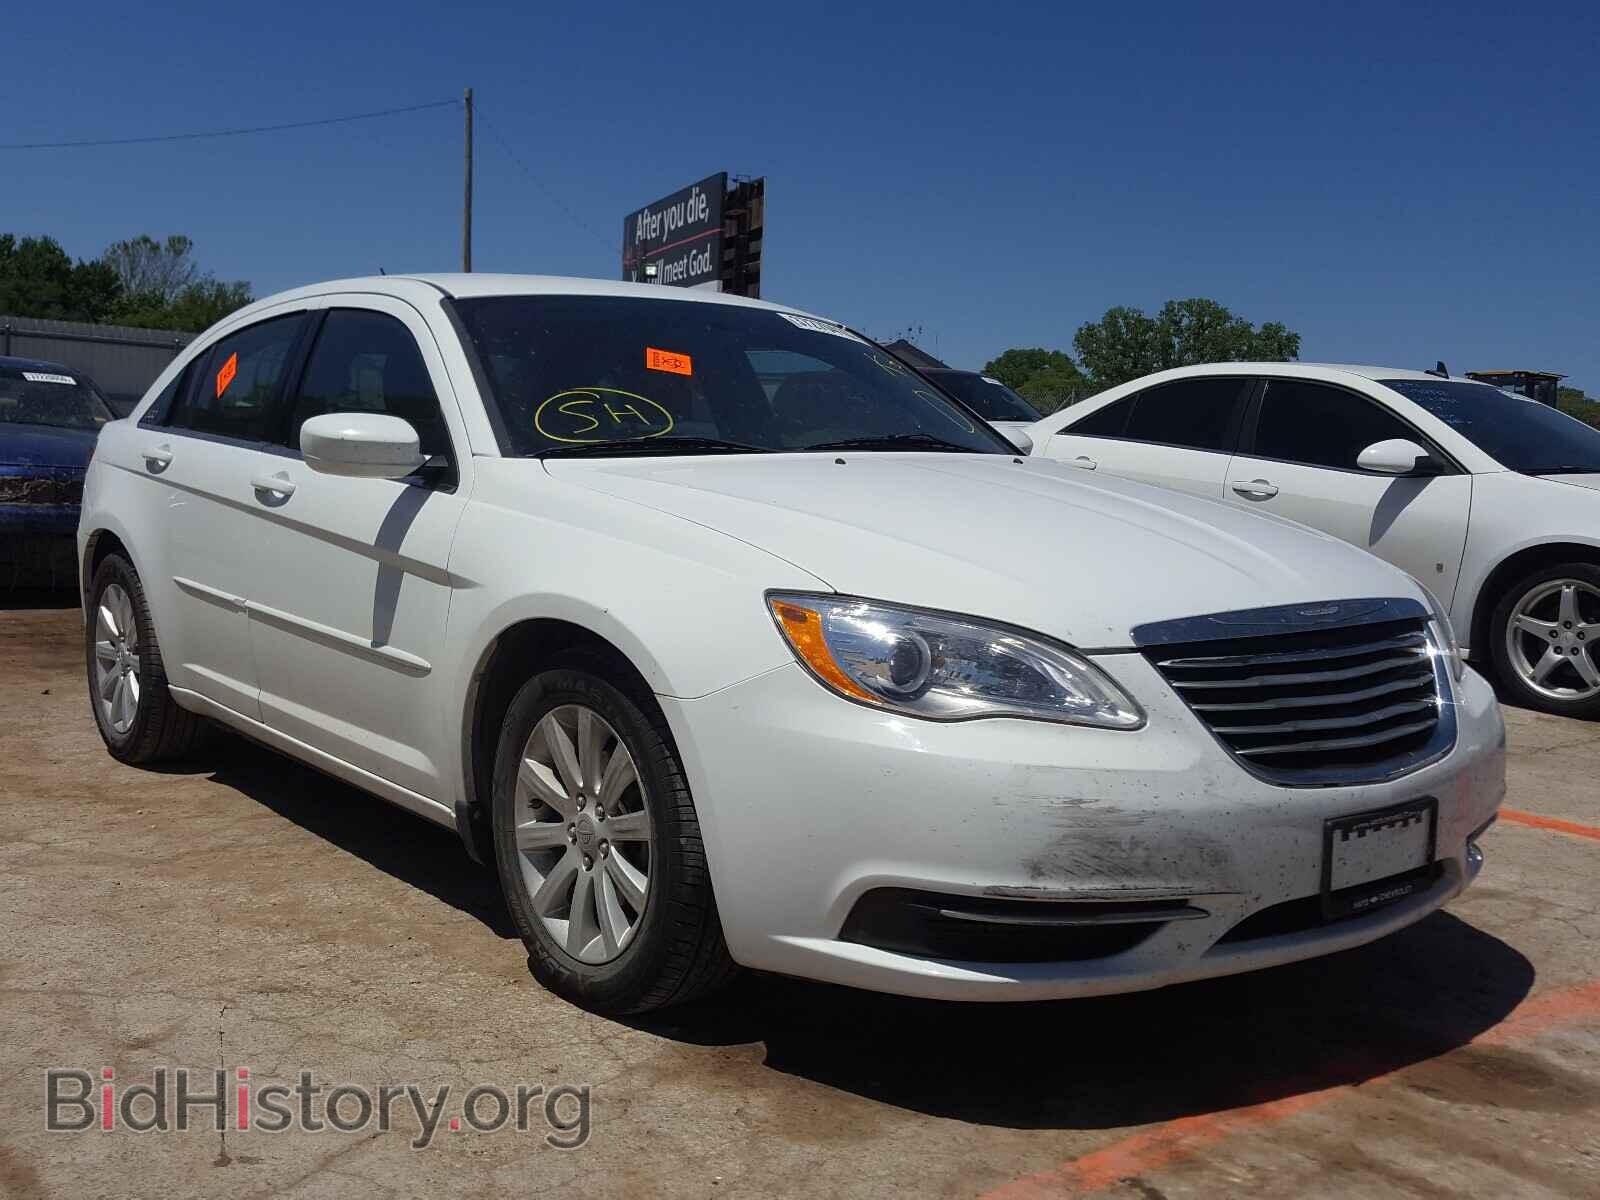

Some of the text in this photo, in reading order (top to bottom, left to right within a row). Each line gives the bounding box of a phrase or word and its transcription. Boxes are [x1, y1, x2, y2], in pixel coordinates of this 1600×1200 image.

[635, 186, 710, 245] After you die,
[664, 254, 688, 284] meet
[689, 243, 713, 276] God.
